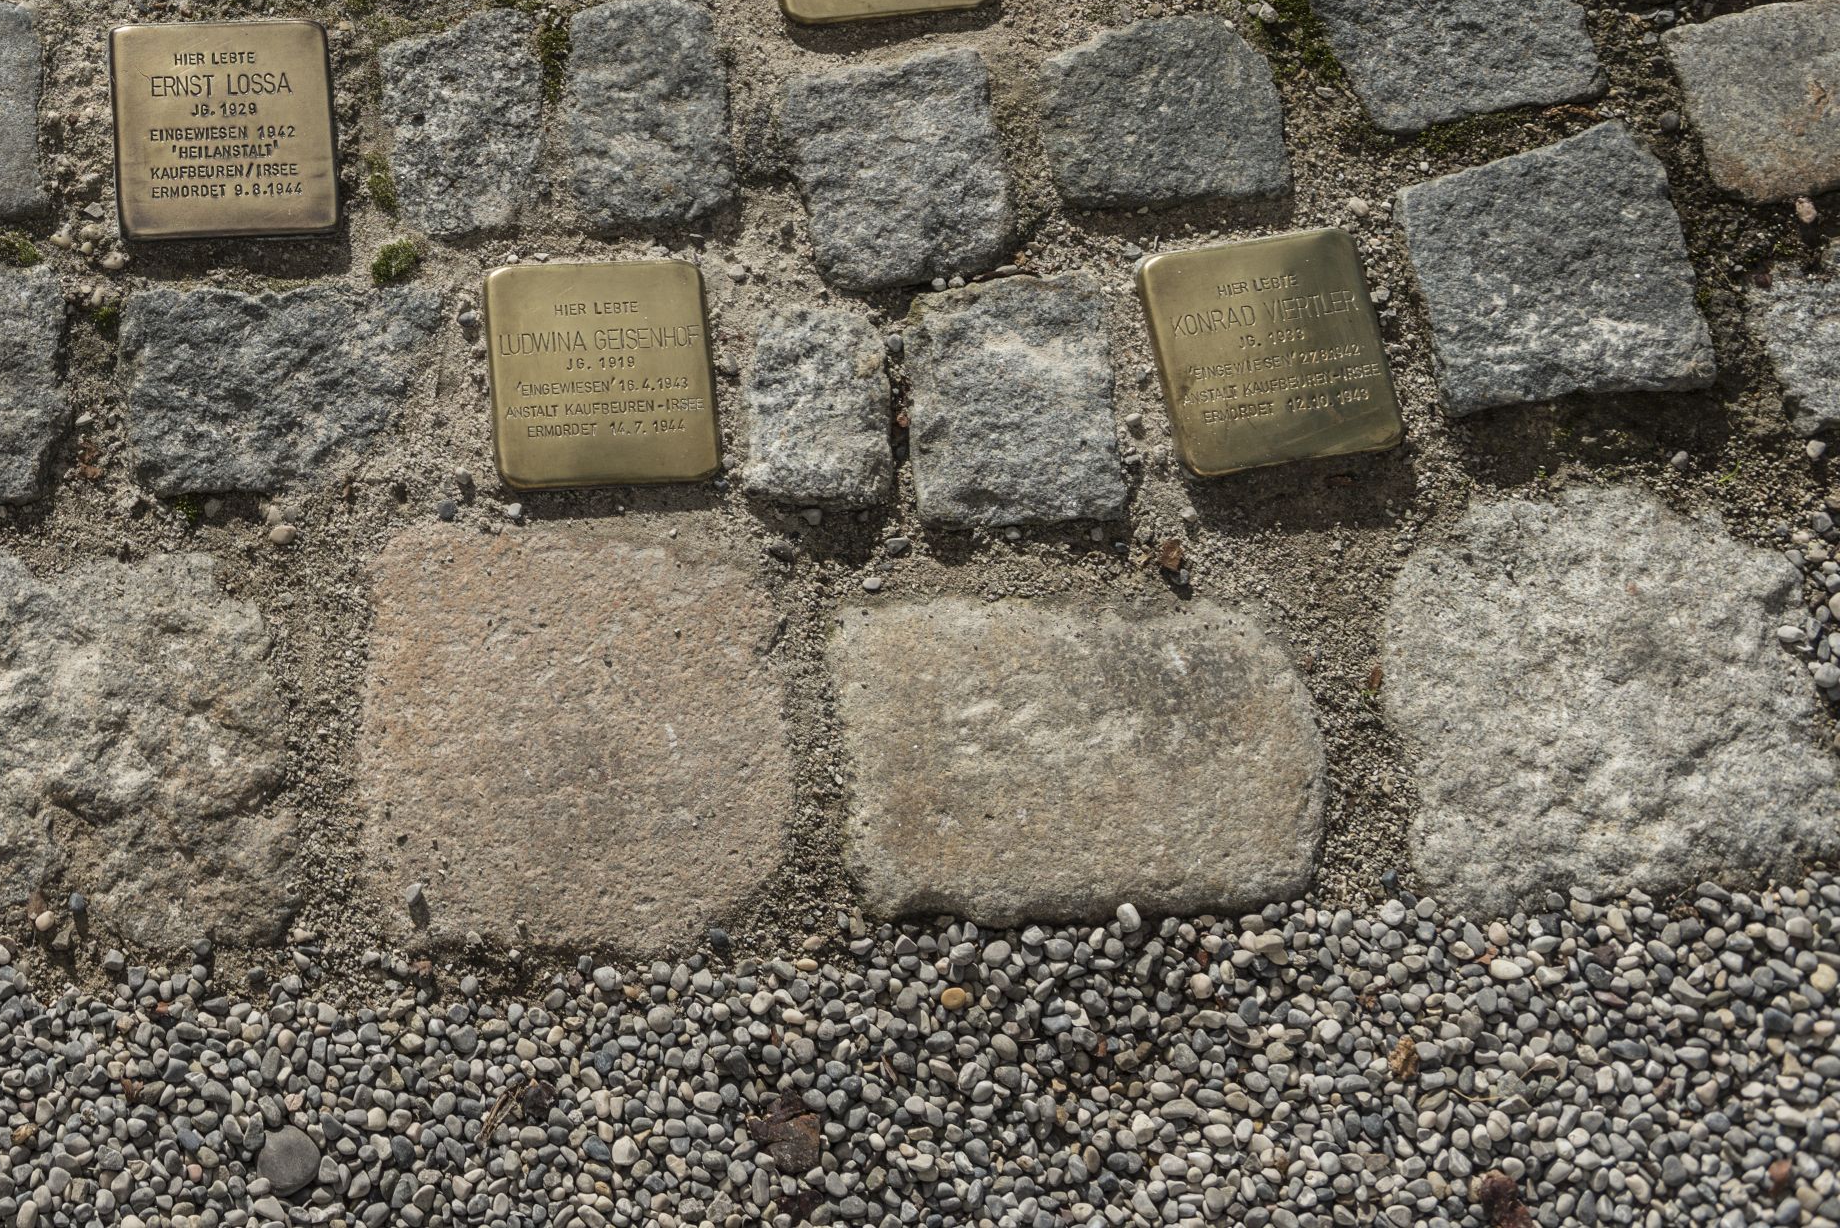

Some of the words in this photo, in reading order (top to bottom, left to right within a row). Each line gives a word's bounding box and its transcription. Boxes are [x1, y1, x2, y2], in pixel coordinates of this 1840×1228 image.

[174, 53, 205, 65] HIER
[212, 52, 255, 65] LEBTE
[151, 74, 214, 97] ERNST
[227, 72, 292, 95] LOSSA
[191, 104, 215, 117] JG.
[220, 103, 257, 116] 1929
[150, 126, 248, 142] EINGEWIESEN
[257, 126, 295, 139] 1942
[150, 163, 298, 181] KAUFBEUREN/IRSEE
[152, 184, 226, 199] ERMORDET
[1217, 282, 1248, 298] HIER
[1255, 274, 1299, 292] LEBTE
[554, 303, 586, 316] HIER
[594, 301, 639, 315] LEBTE
[1170, 304, 1256, 338] KONRAD
[1264, 290, 1359, 323] VIERTLER
[499, 331, 587, 357] LUDWINA
[594, 324, 701, 351] GEISENHOF
[1239, 335, 1261, 349] JG.
[1268, 328, 1305, 345] 1933
[566, 358, 592, 371] JG.
[599, 356, 635, 369] 1919
[1183, 384, 1238, 407] ANSTALT
[505, 405, 559, 419] ANSTALT
[1203, 402, 1274, 424] ERMORDET
[528, 423, 598, 438] ERMORDET
